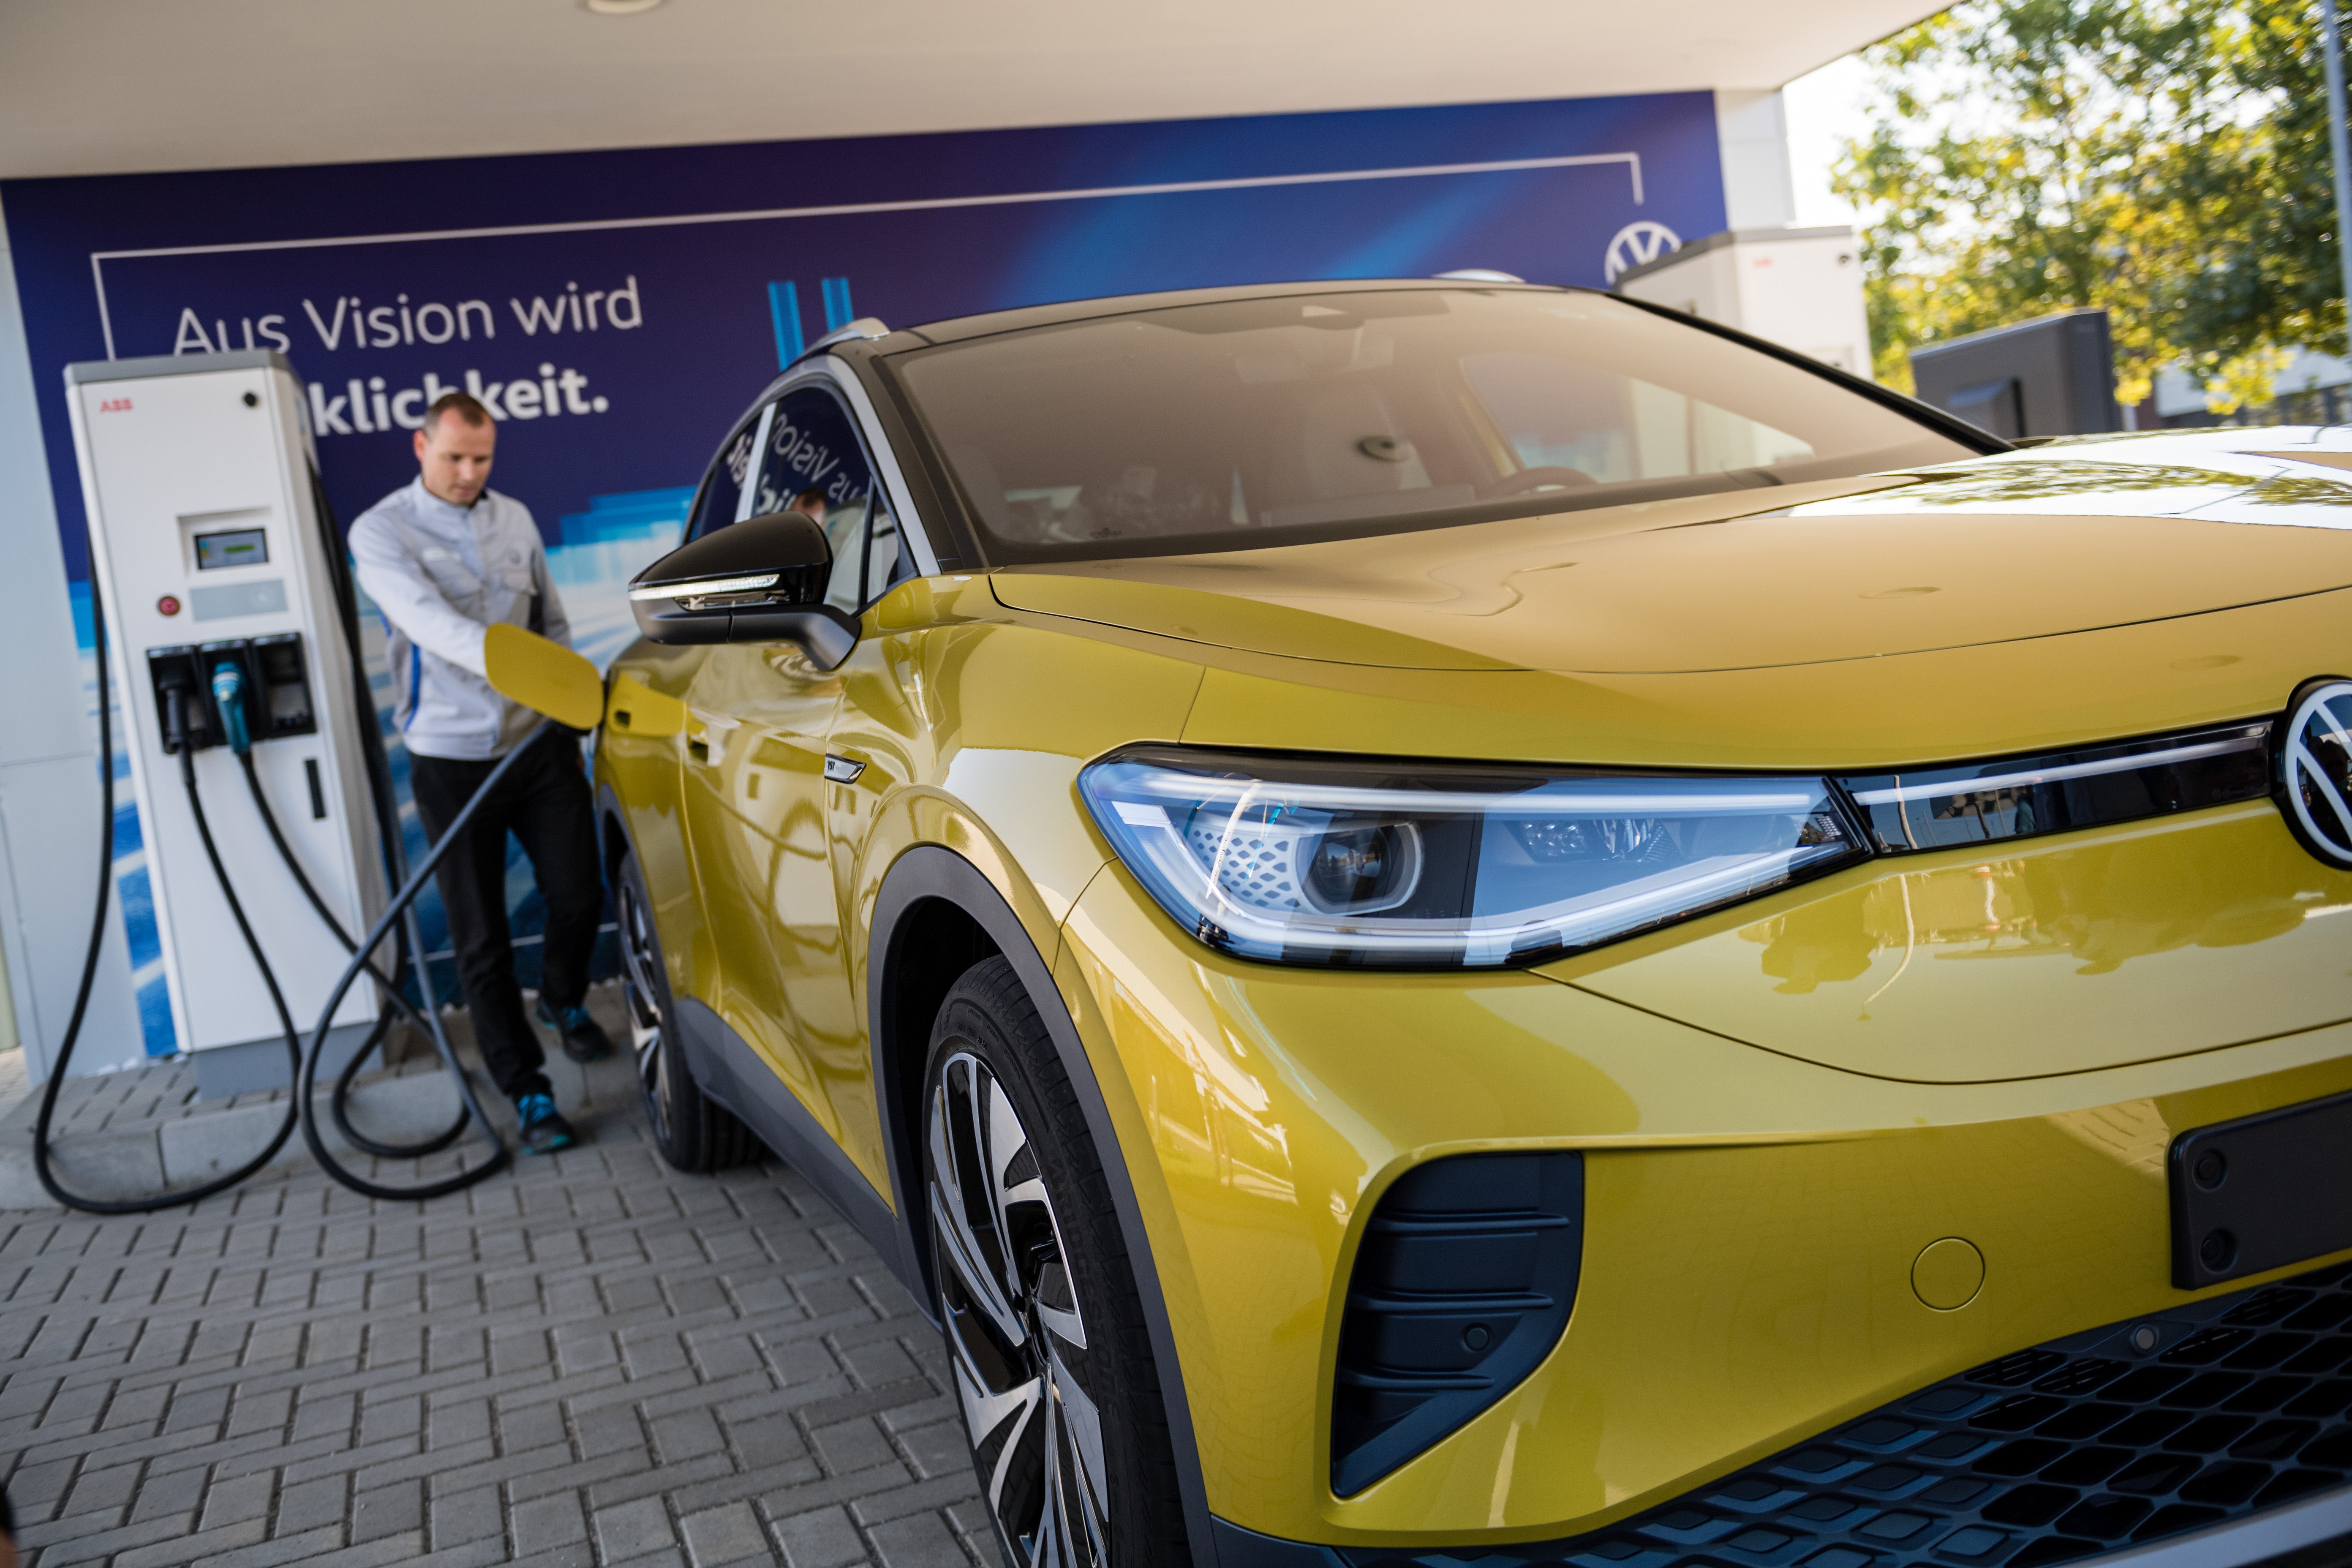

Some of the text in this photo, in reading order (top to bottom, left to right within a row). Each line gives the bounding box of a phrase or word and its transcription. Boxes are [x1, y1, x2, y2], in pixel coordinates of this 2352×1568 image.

[173, 275, 642, 356] Aus Vision wird
[307, 362, 609, 436] klickeit.
